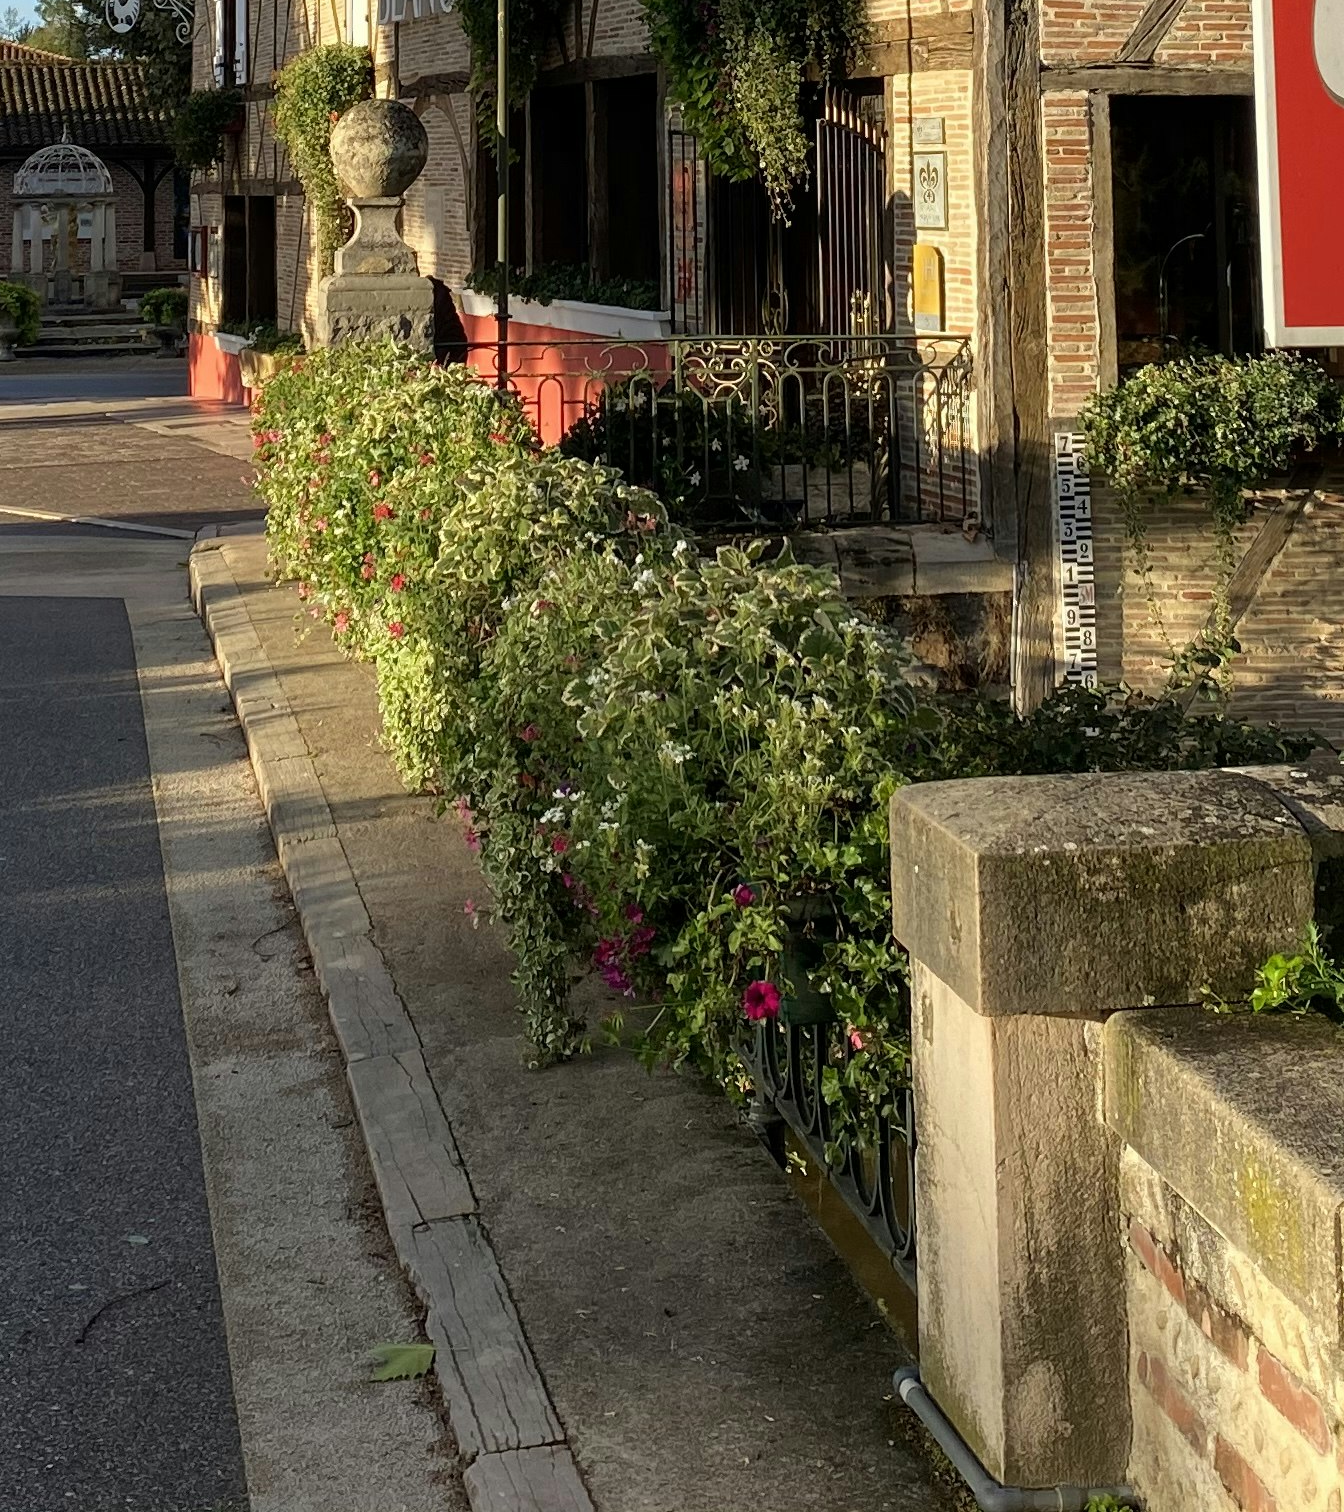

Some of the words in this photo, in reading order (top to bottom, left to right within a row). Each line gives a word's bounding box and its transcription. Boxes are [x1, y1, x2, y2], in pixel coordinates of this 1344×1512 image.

[1059, 435, 1069, 452] 7
[1061, 478, 1071, 494] 5
[1076, 498, 1088, 515] 4
[1063, 521, 1073, 538] 3
[1080, 542, 1090, 559] 2
[1066, 565, 1074, 582] 1
[1066, 609, 1076, 626] 9
[1083, 629, 1093, 647] 8
[1068, 653, 1078, 670] 7
[1084, 673, 1094, 688] 6
